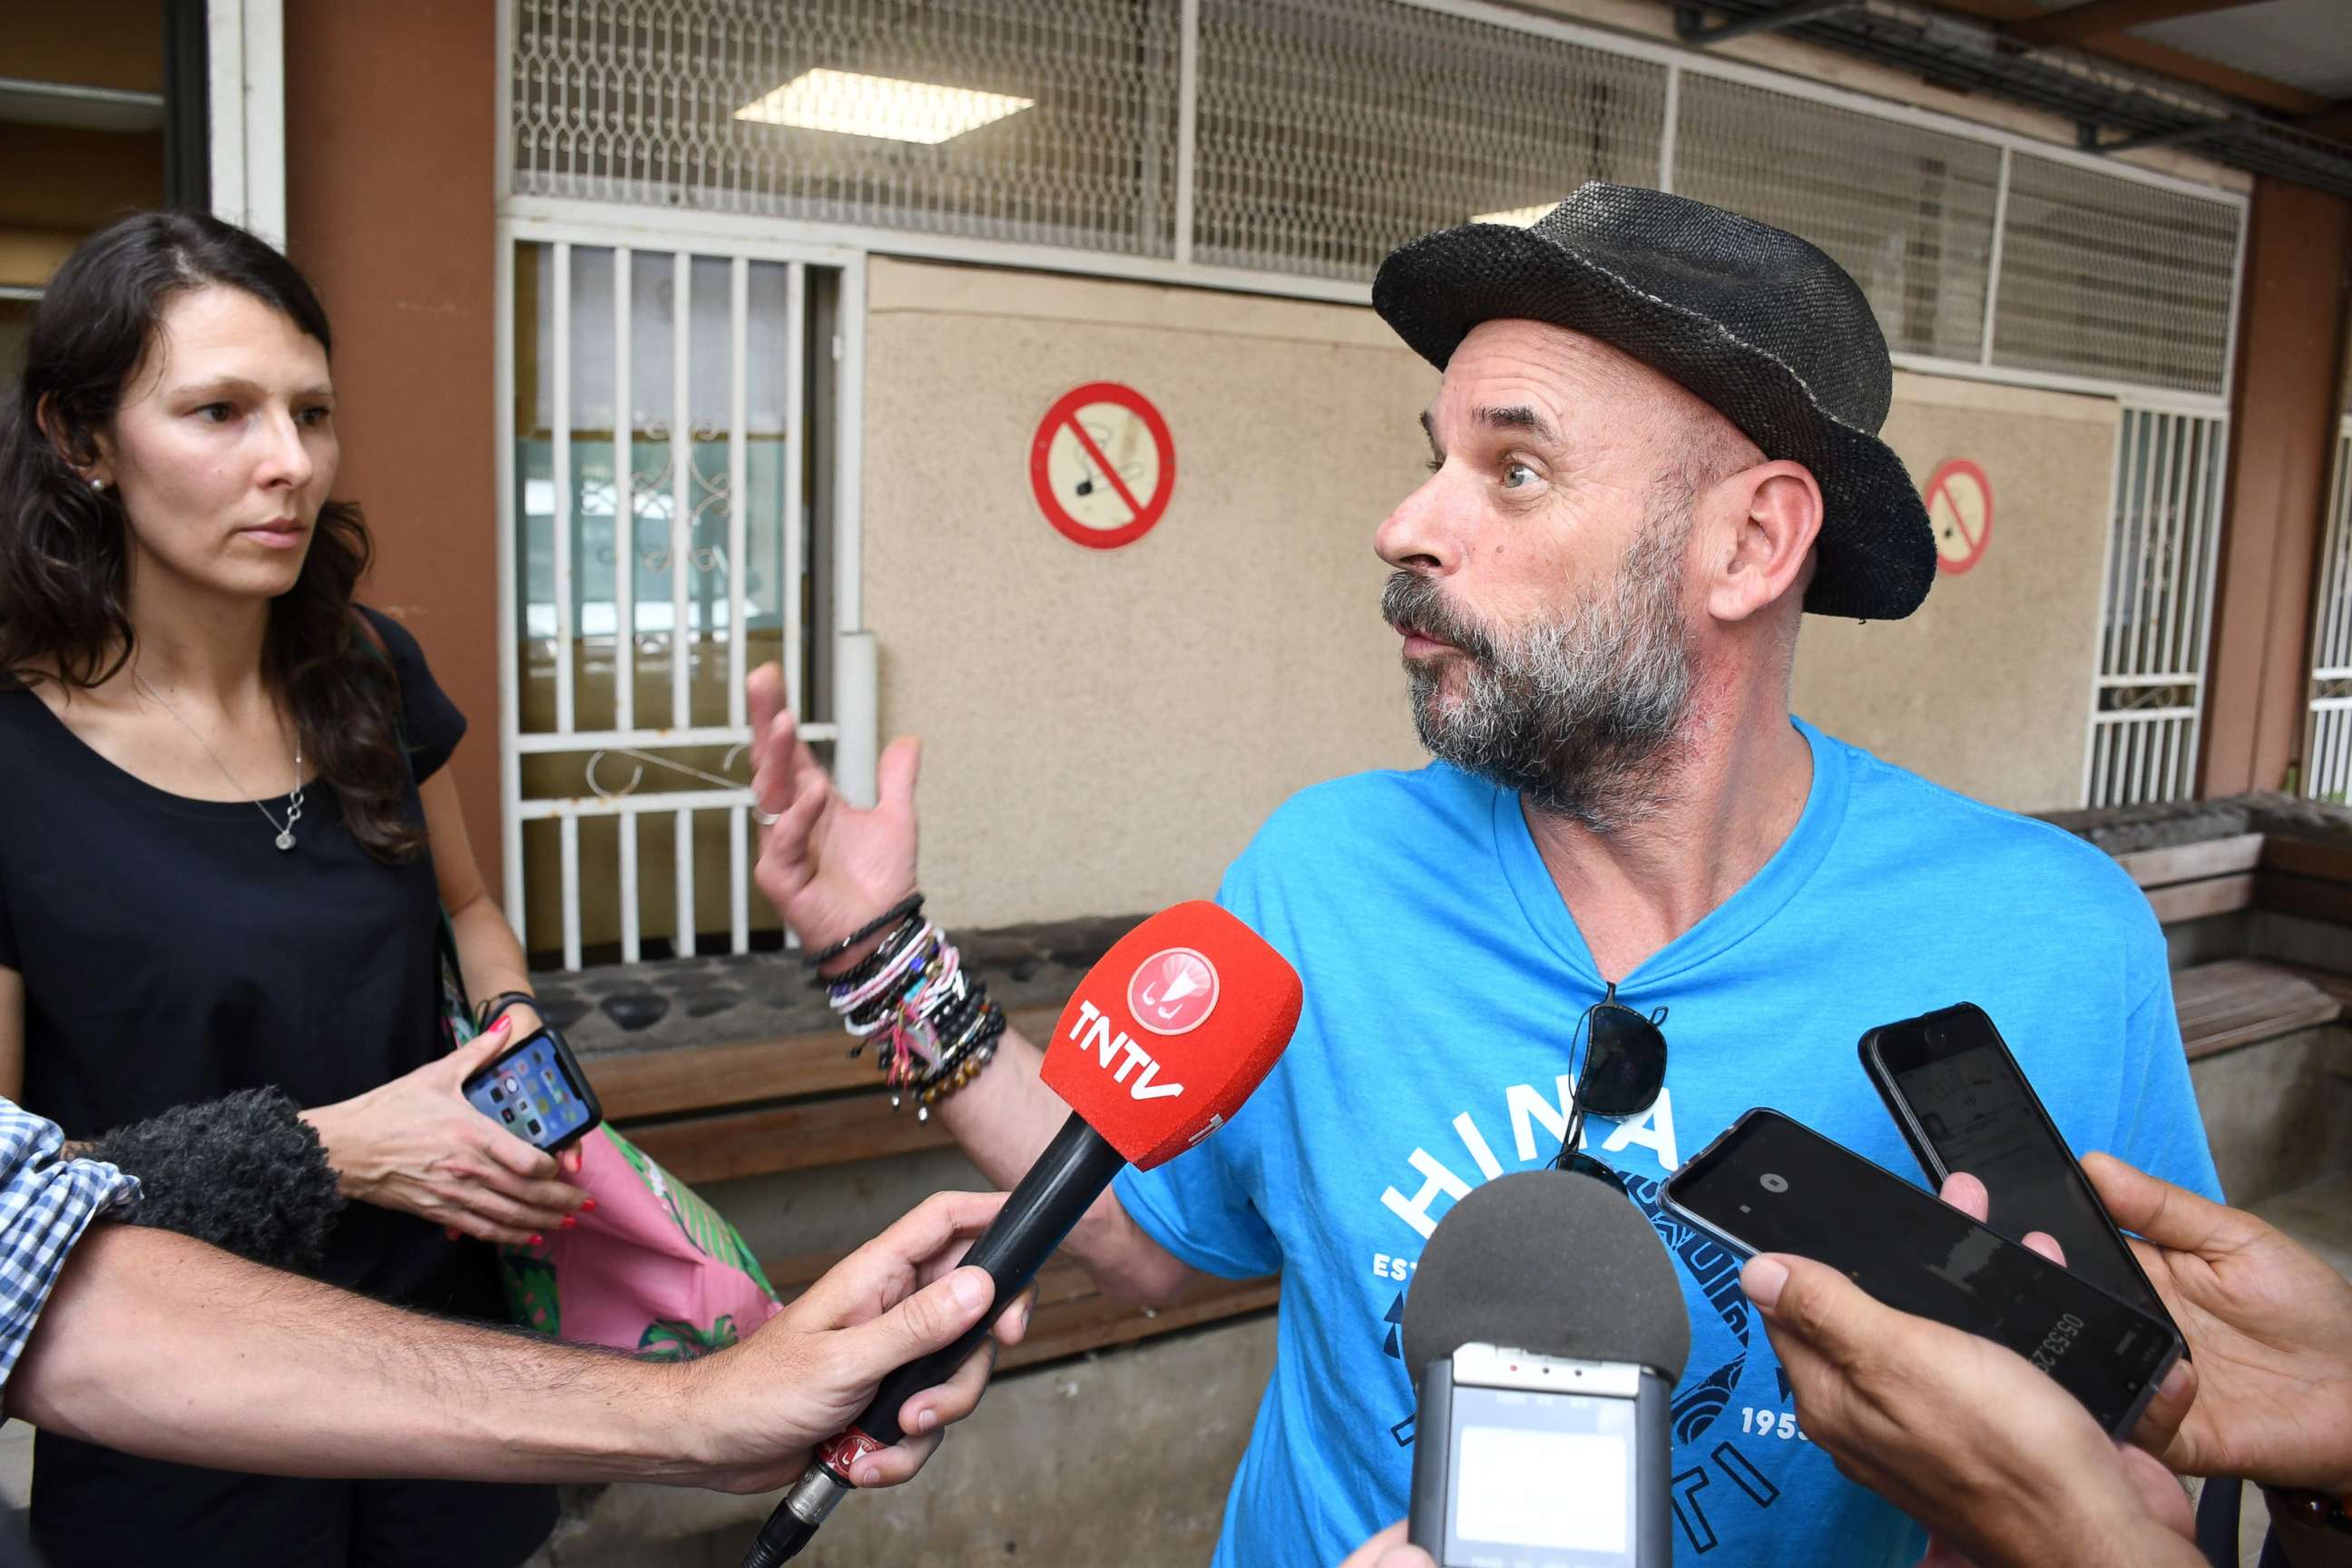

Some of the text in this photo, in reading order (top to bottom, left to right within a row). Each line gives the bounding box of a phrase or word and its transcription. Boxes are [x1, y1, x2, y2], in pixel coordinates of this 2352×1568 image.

[1069, 999, 1184, 1100] TNTV
[1380, 1074, 1679, 1240] HINA
[1373, 1252, 1417, 1281] ES
[1741, 1406, 1809, 1441] 195
